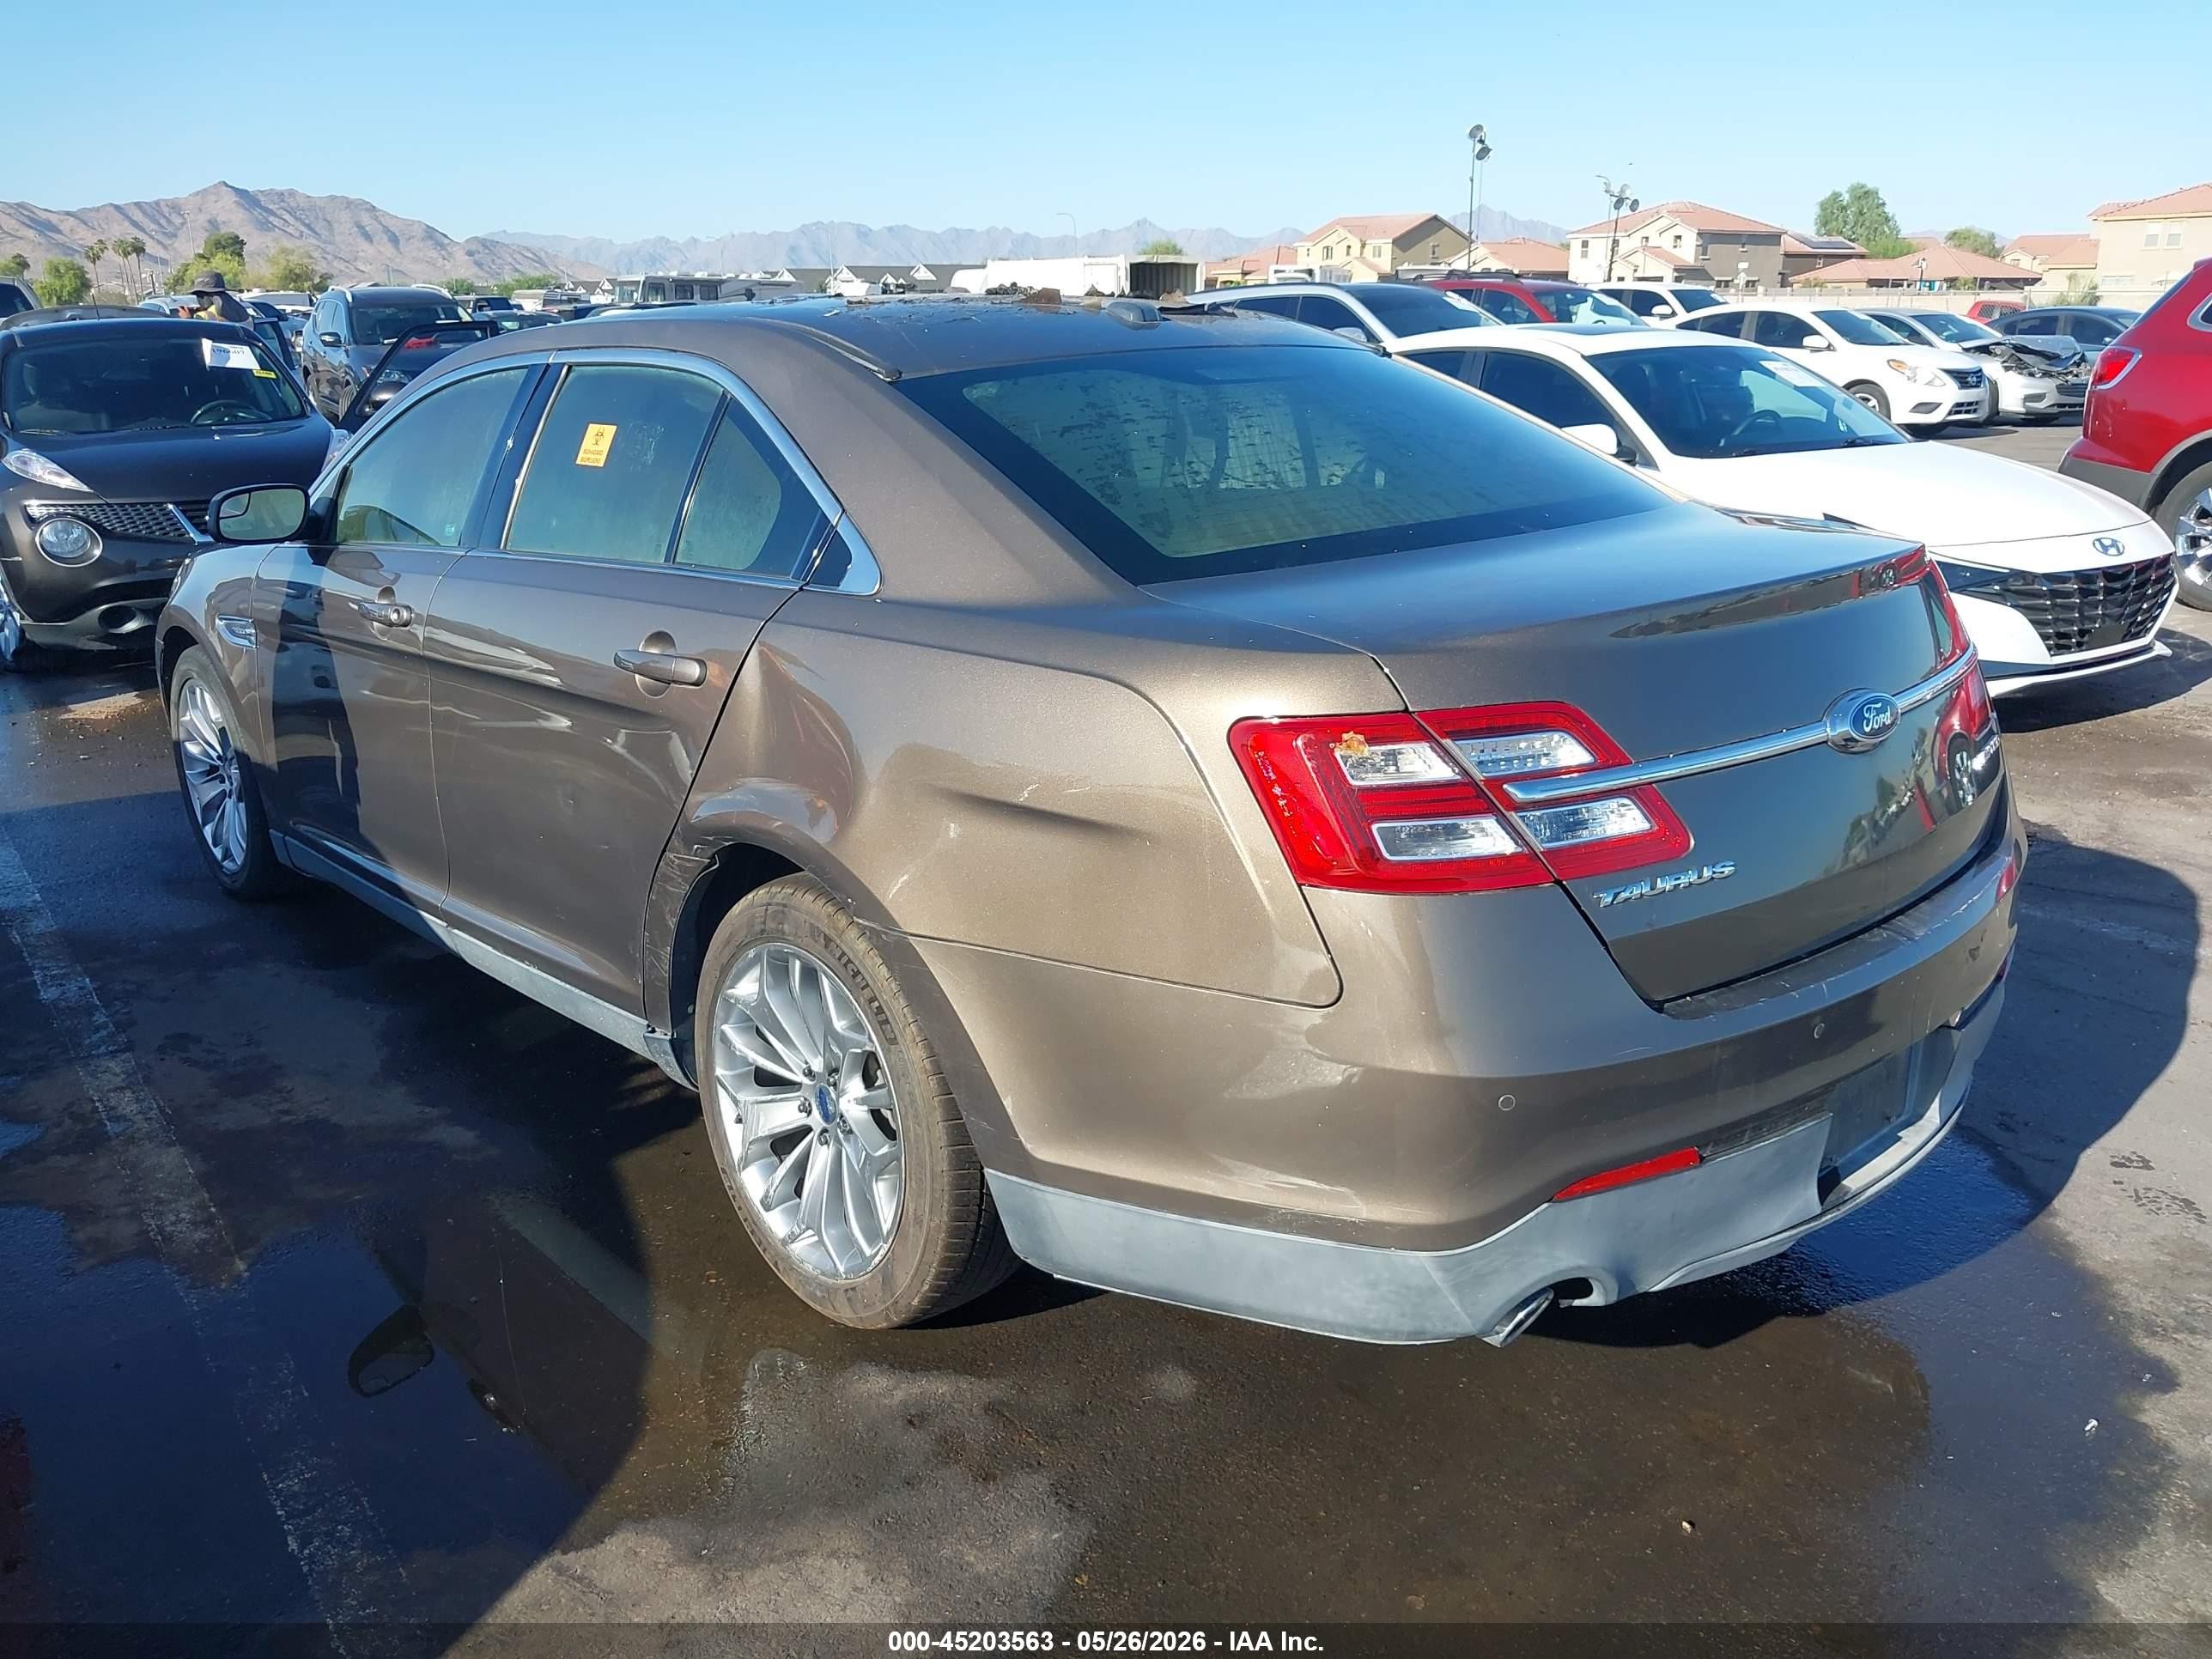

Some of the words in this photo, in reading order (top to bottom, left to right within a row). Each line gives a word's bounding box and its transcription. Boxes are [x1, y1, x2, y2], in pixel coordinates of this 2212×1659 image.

[1863, 702, 1891, 733] Ford
[1593, 860, 1736, 908] TAURUS
[826, 941, 898, 1045] MICHELIN
